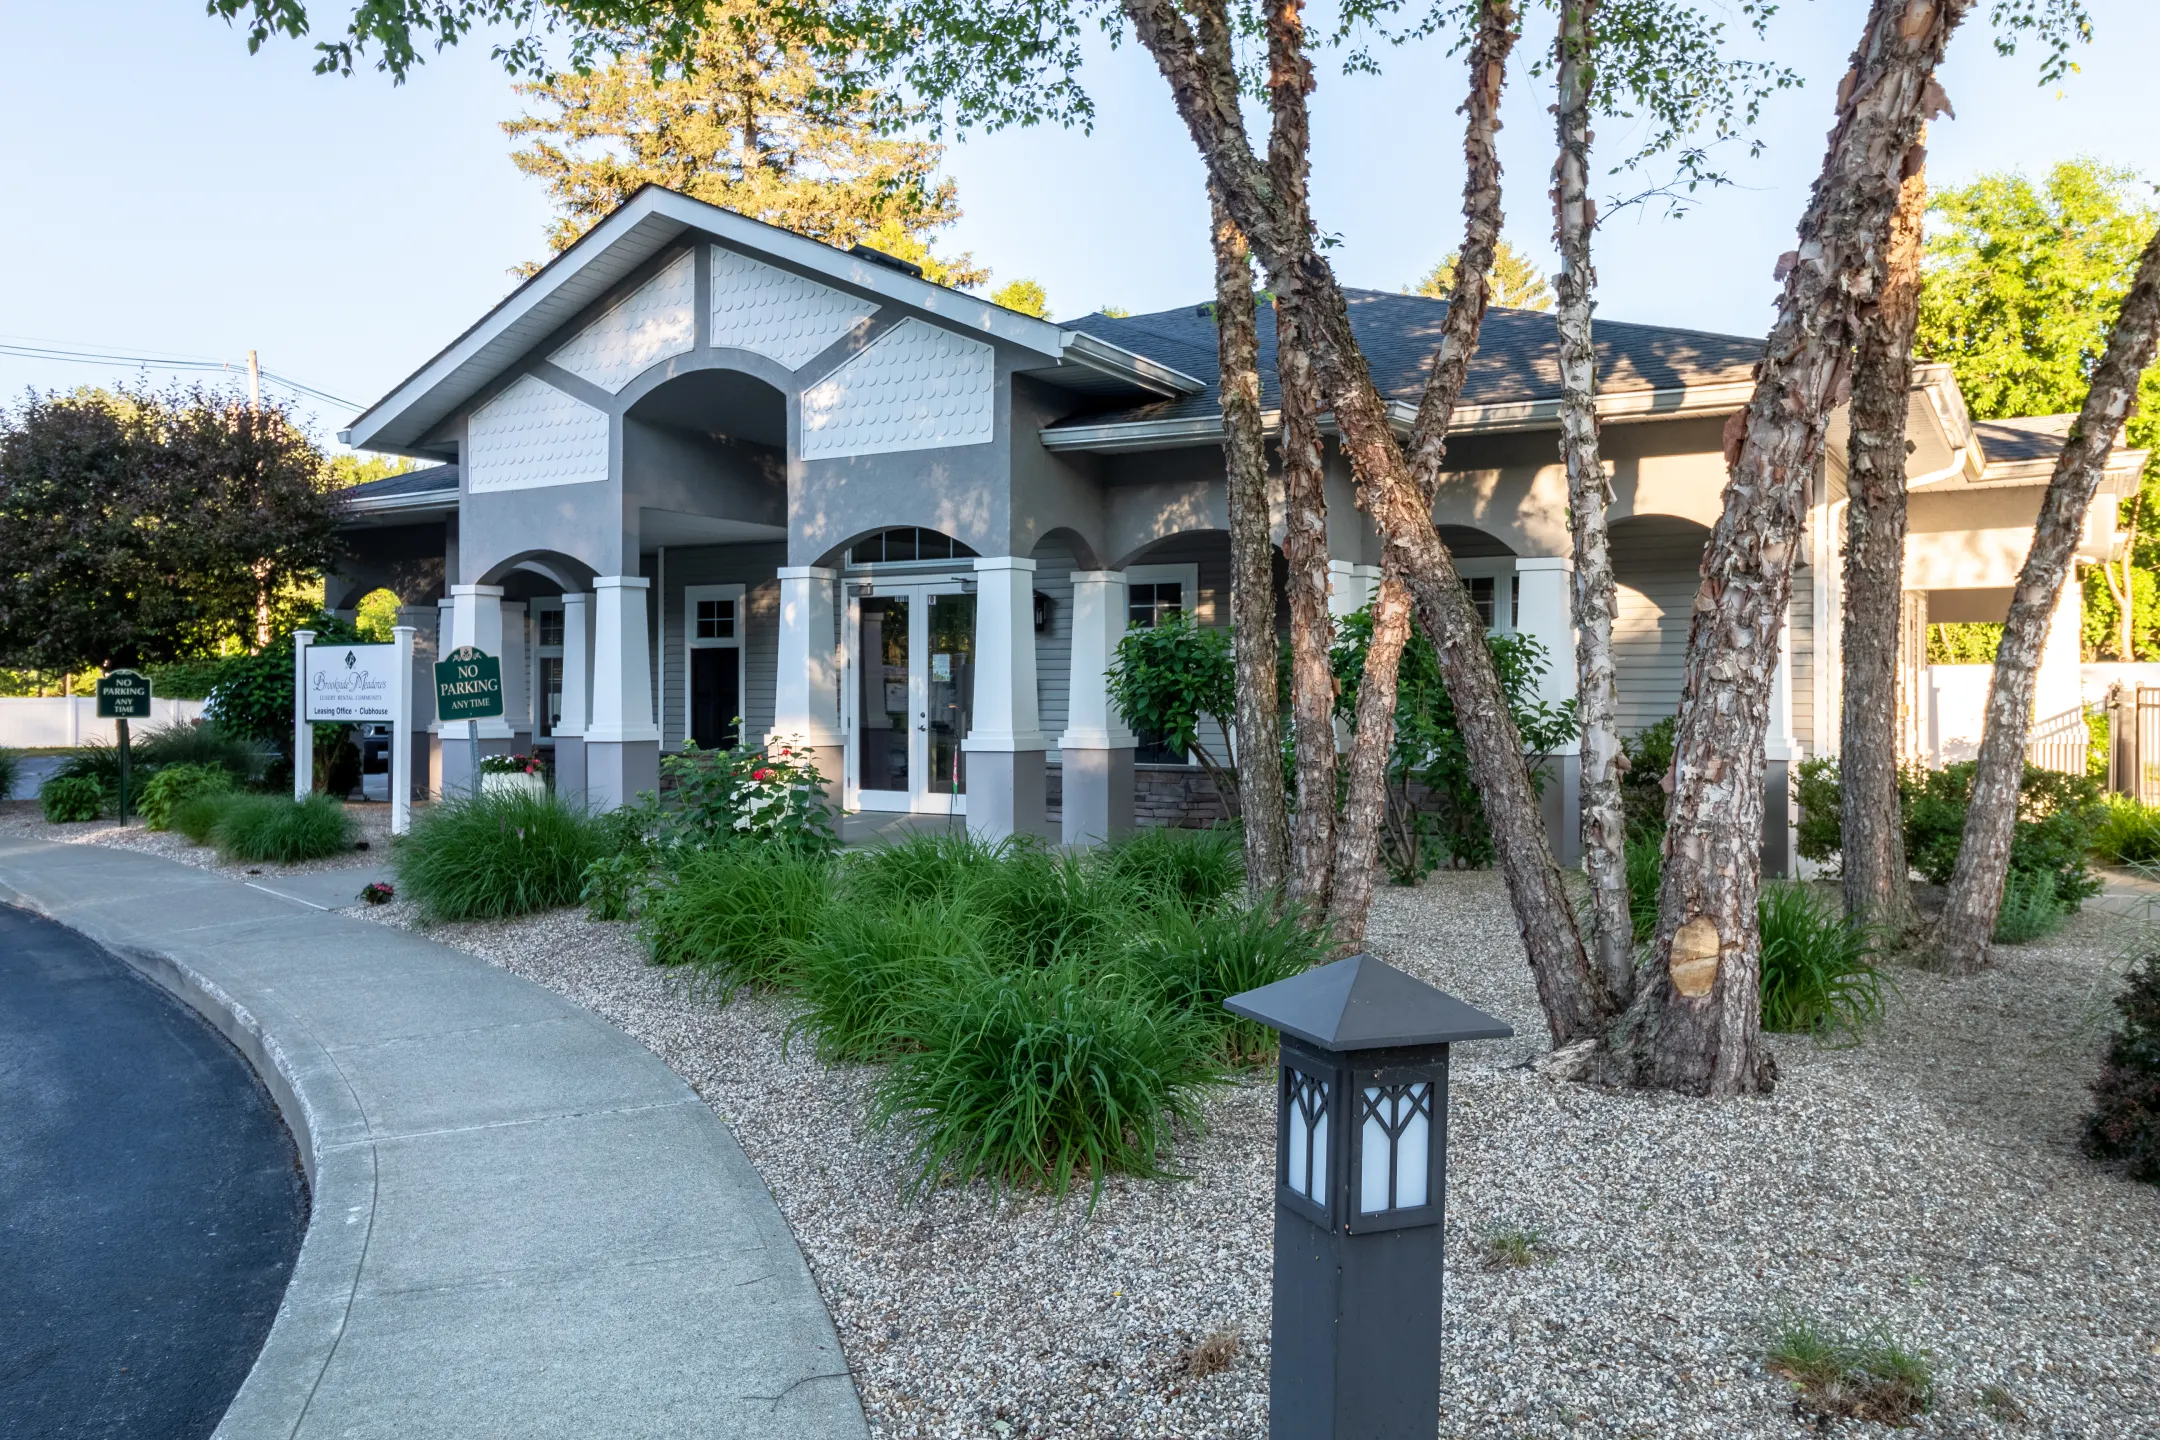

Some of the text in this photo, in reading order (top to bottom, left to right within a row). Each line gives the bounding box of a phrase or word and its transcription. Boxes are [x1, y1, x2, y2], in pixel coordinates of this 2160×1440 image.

[458, 664, 478, 679] NO
[116, 679, 132, 687] NO
[313, 670, 387, 692] Brookside Meadows
[103, 687, 145, 696] PARKING
[440, 678, 498, 697] PARKING
[452, 698, 490, 710] ANY TIME
[314, 707, 388, 716] Leasing Office Clubhouse
